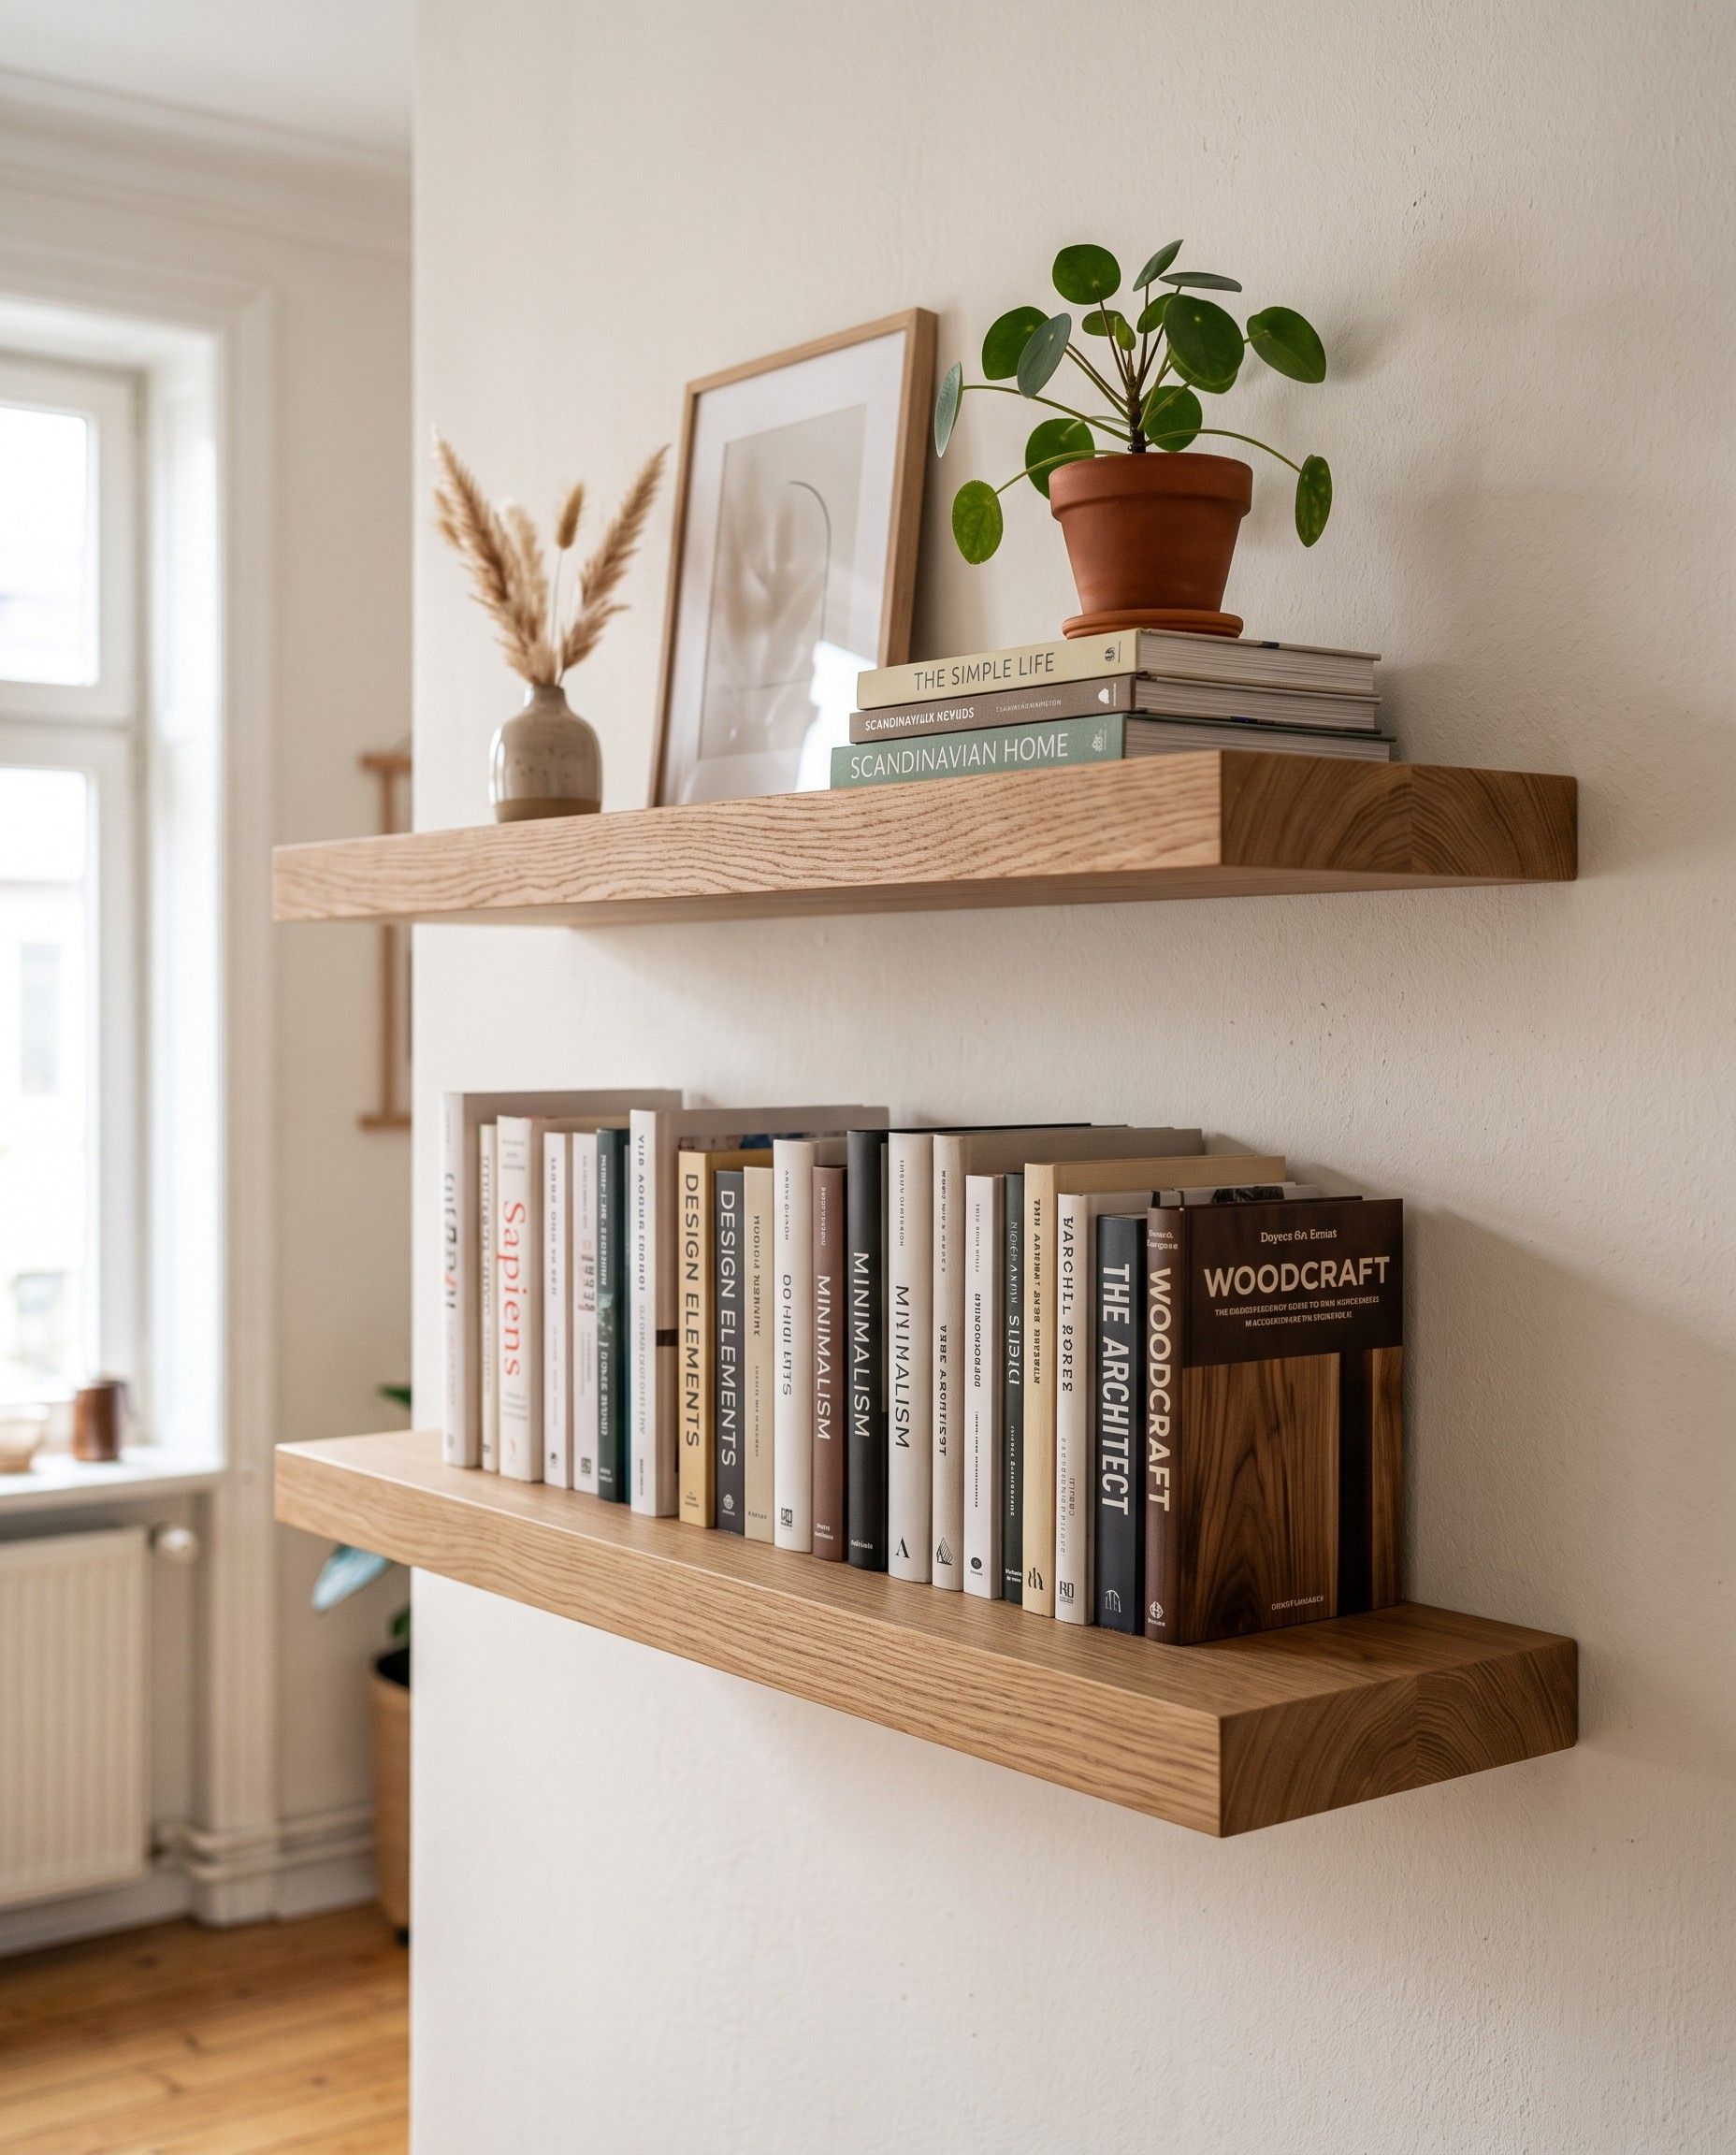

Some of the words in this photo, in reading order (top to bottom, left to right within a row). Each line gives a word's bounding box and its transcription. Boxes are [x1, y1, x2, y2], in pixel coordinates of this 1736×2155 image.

[914, 669, 946, 692] THE
[951, 658, 1013, 687] SIMPLE
[1019, 652, 1055, 676] LIFE
[850, 740, 997, 780] SCANDINAVIAN
[1004, 732, 1069, 763] HOME
[497, 1201, 528, 1377] Sapiens
[685, 1174, 700, 1282] DESIGN
[719, 1190, 736, 1299] DESIGN
[1102, 1263, 1130, 1325] THE
[1203, 1255, 1391, 1298] WOODCRAFT
[685, 1292, 700, 1449] ELEMENTS
[720, 1309, 737, 1468] ELEMENTS
[817, 1274, 832, 1441] MINIMALISM
[853, 1251, 870, 1439] MINIMALISM
[1148, 1266, 1172, 1512] WOODCRAFT
[1101, 1335, 1130, 1516] ARCHITECT
